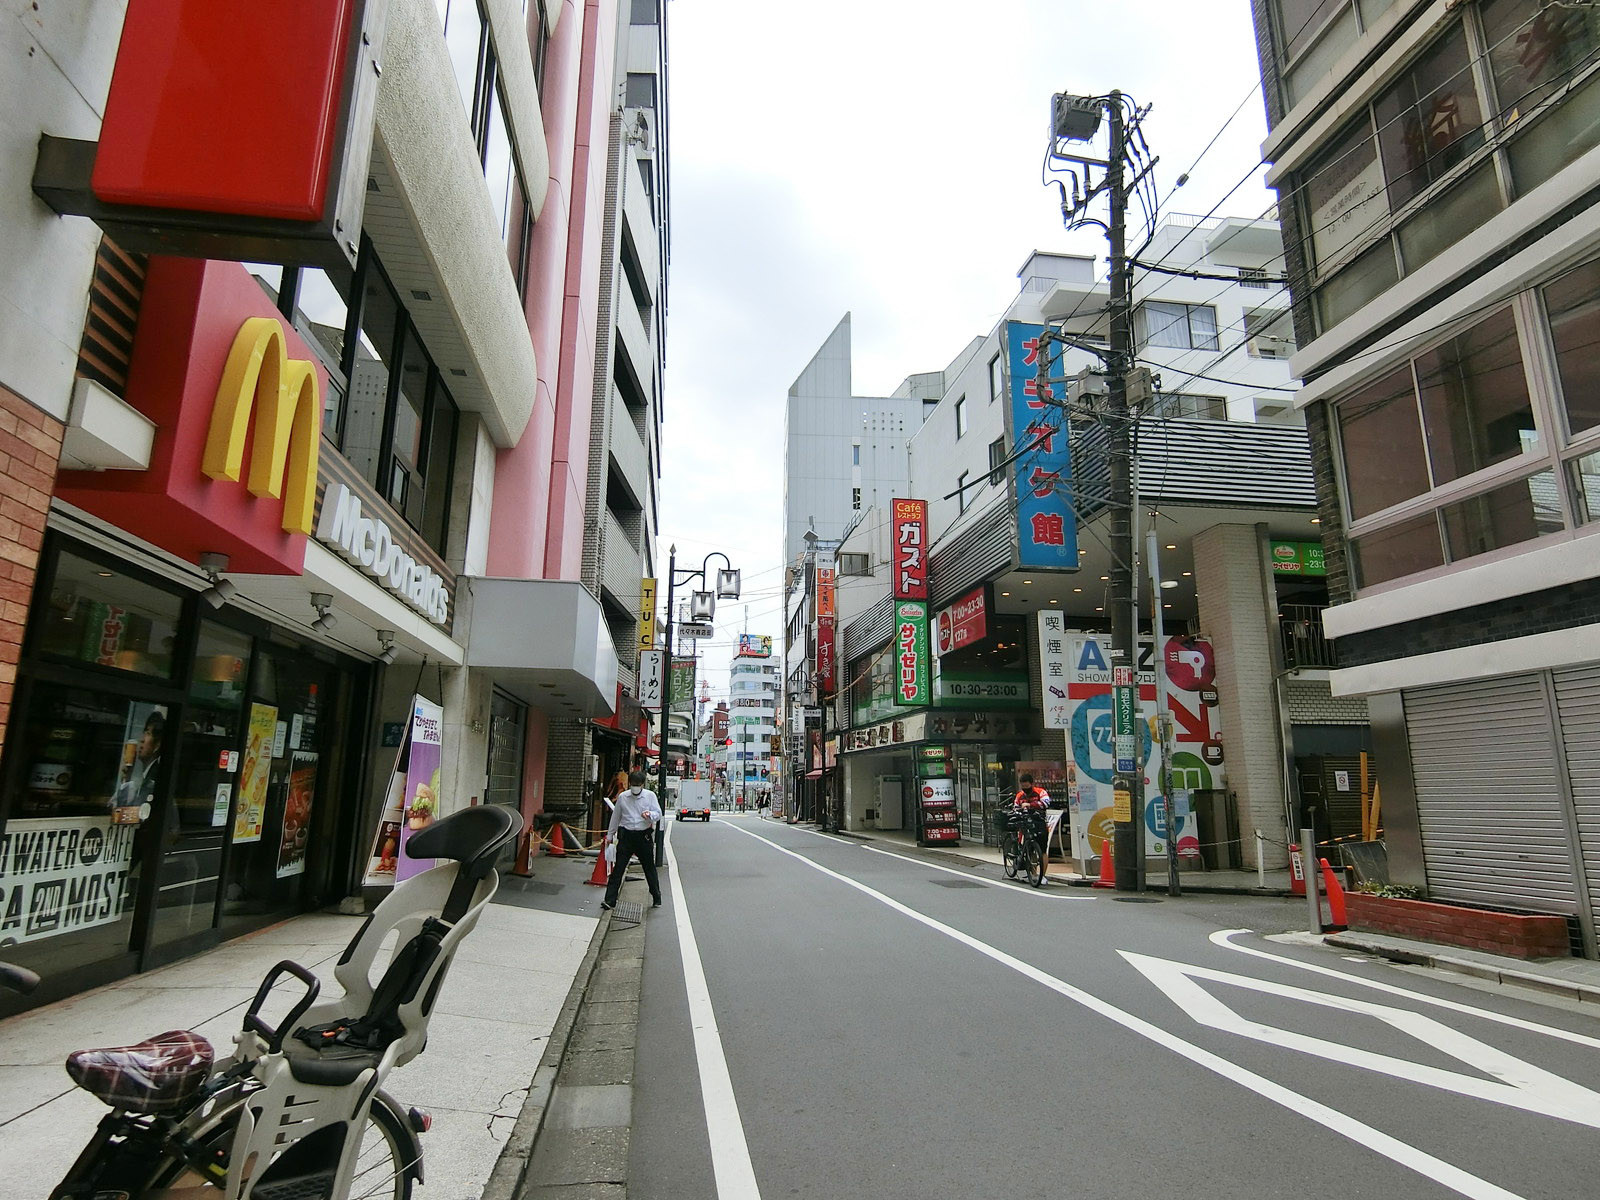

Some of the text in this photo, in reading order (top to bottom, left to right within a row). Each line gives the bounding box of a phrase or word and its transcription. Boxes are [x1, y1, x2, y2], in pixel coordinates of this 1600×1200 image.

[896, 502, 922, 513] Café
[898, 521, 922, 594] ガスト
[1272, 561, 1301, 571] サイゼリヤ
[901, 622, 918, 700] サイゼリヤ
[1045, 615, 1063, 678] 喫煙室
[647, 653, 660, 700] らーめん
[63, 869, 129, 928] MOST
